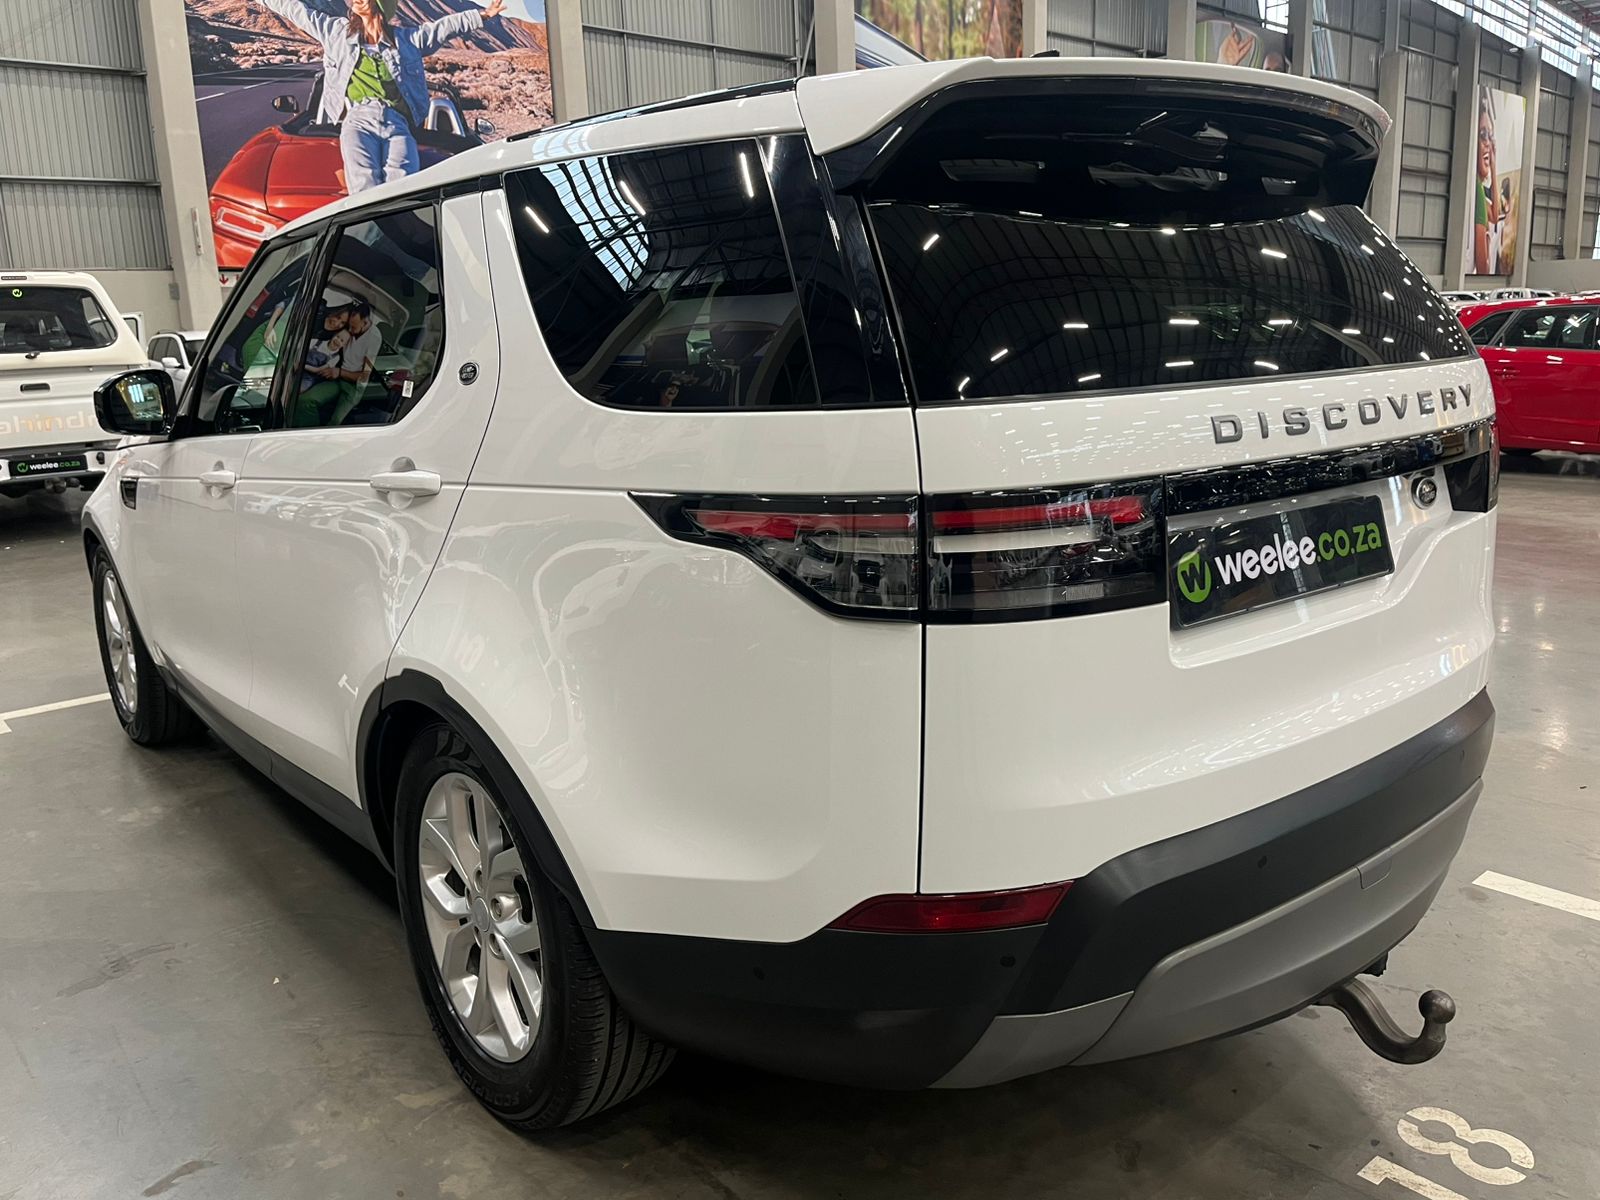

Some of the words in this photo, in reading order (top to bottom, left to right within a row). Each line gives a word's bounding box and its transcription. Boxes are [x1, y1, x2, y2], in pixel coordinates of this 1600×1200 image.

[0, 411, 97, 434] ahindr
[1211, 384, 1471, 444] DISCOVERY
[1215, 522, 1382, 585] weelee.co.za
[1356, 1106, 1535, 1200] 18
